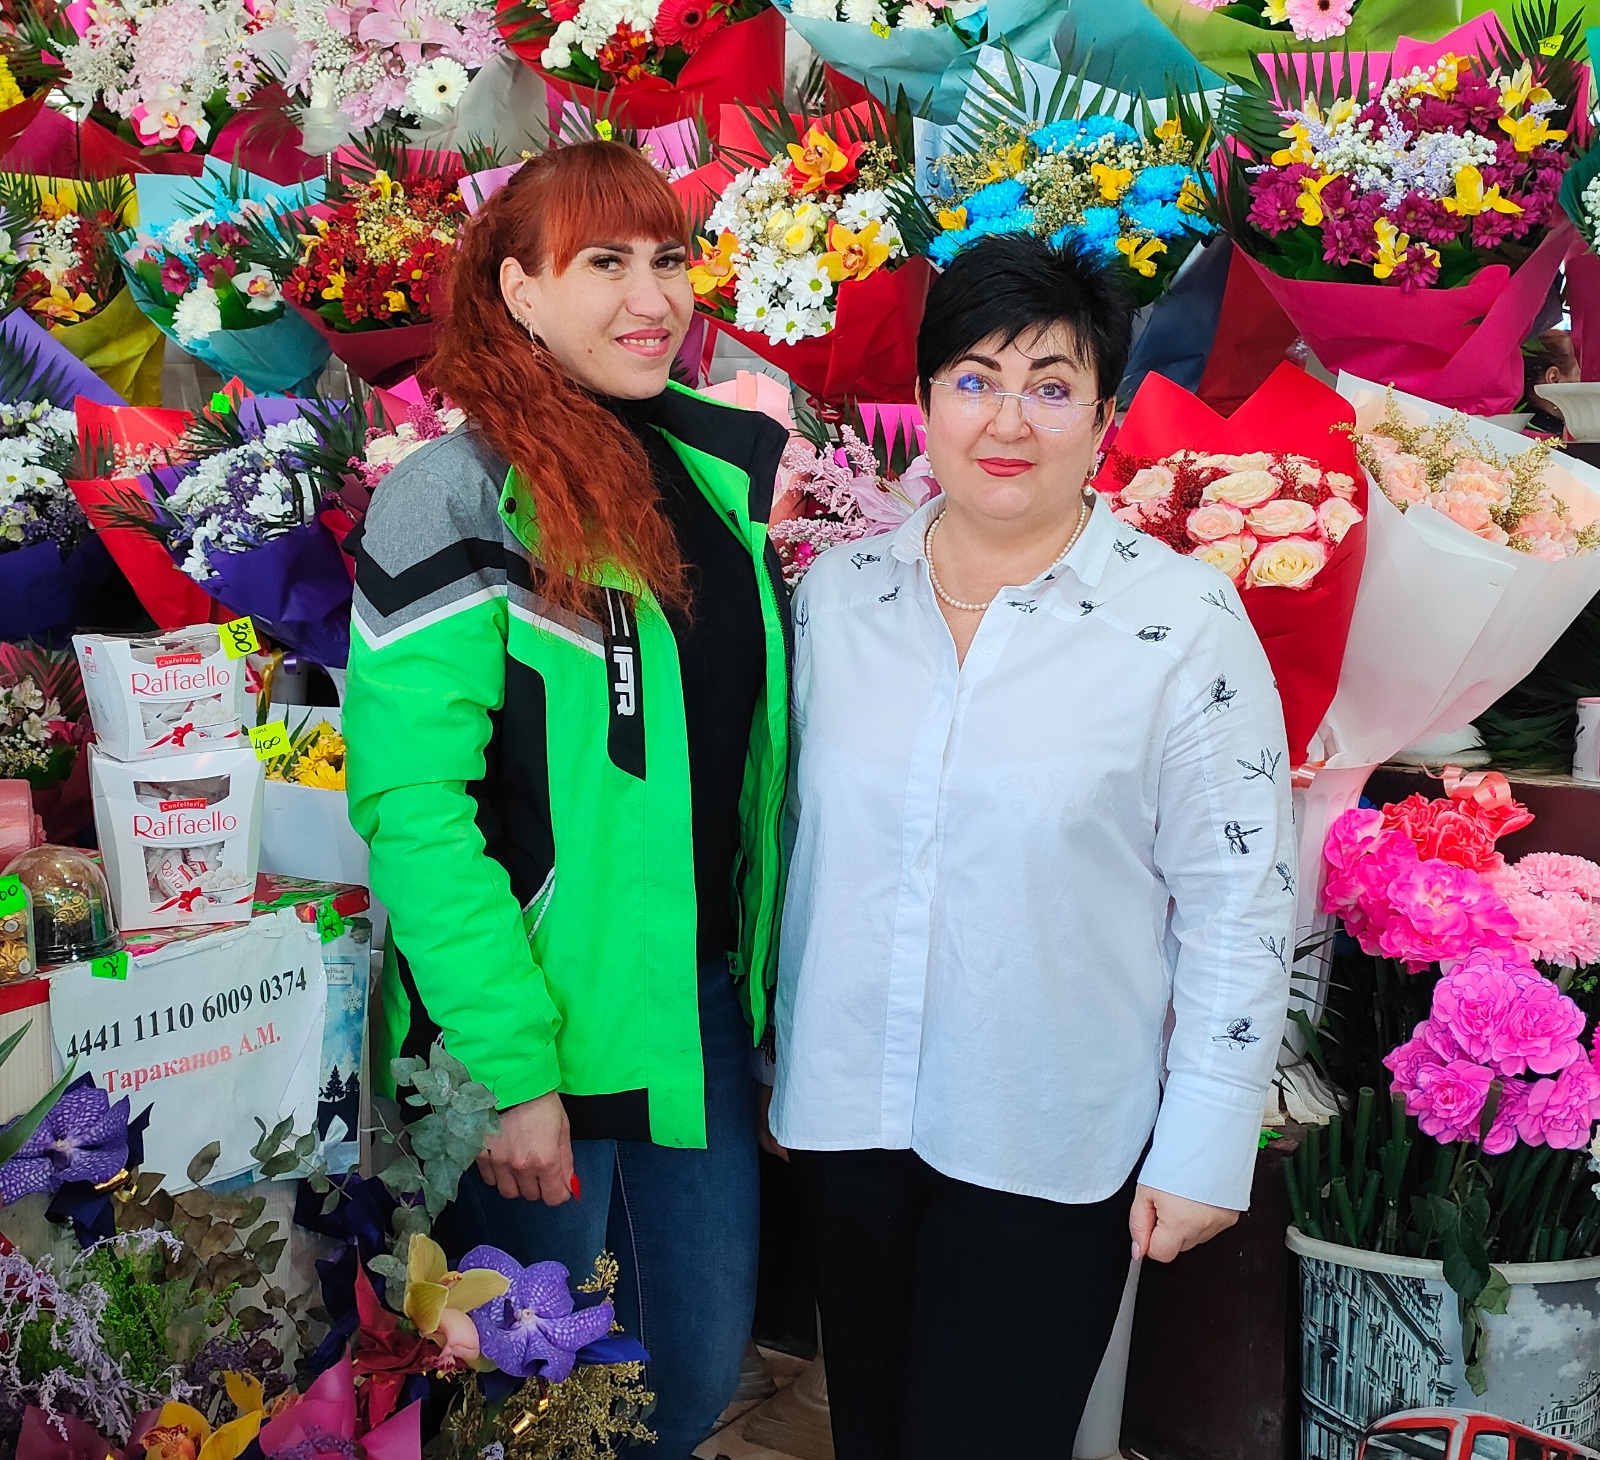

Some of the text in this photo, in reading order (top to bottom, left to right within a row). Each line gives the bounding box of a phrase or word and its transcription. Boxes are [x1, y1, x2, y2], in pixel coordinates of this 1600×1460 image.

[227, 622, 252, 653] 300
[131, 665, 230, 696] Raffaello
[254, 735, 281, 754] 400
[133, 810, 237, 840] Raffaello
[66, 966, 307, 1059] 4441 1110 6009 0374
[102, 1022, 281, 1094] Тараканов А.М.
